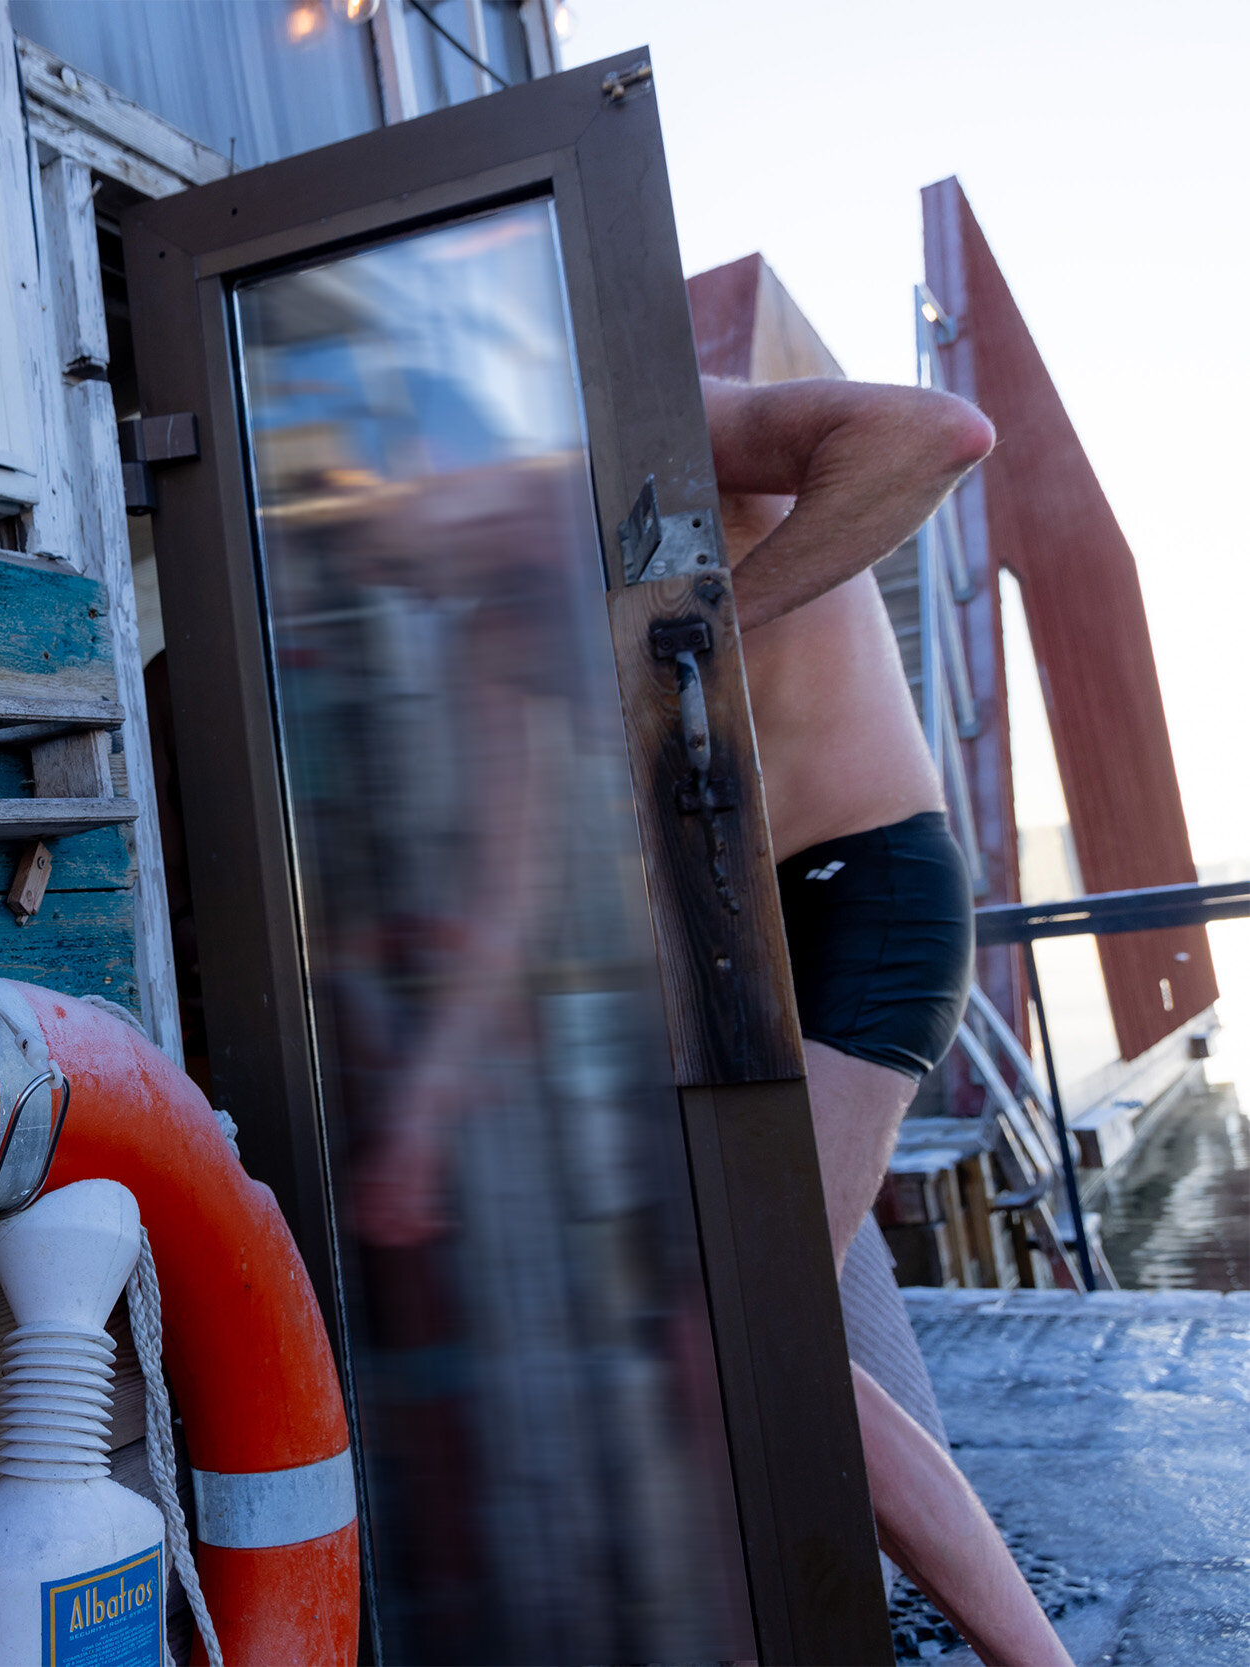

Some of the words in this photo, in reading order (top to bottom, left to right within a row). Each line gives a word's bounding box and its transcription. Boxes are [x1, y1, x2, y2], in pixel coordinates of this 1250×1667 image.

[70, 1577, 152, 1633] Albatros
[70, 1624, 106, 1641] SECURITY
[109, 1615, 127, 1627] ROPE
